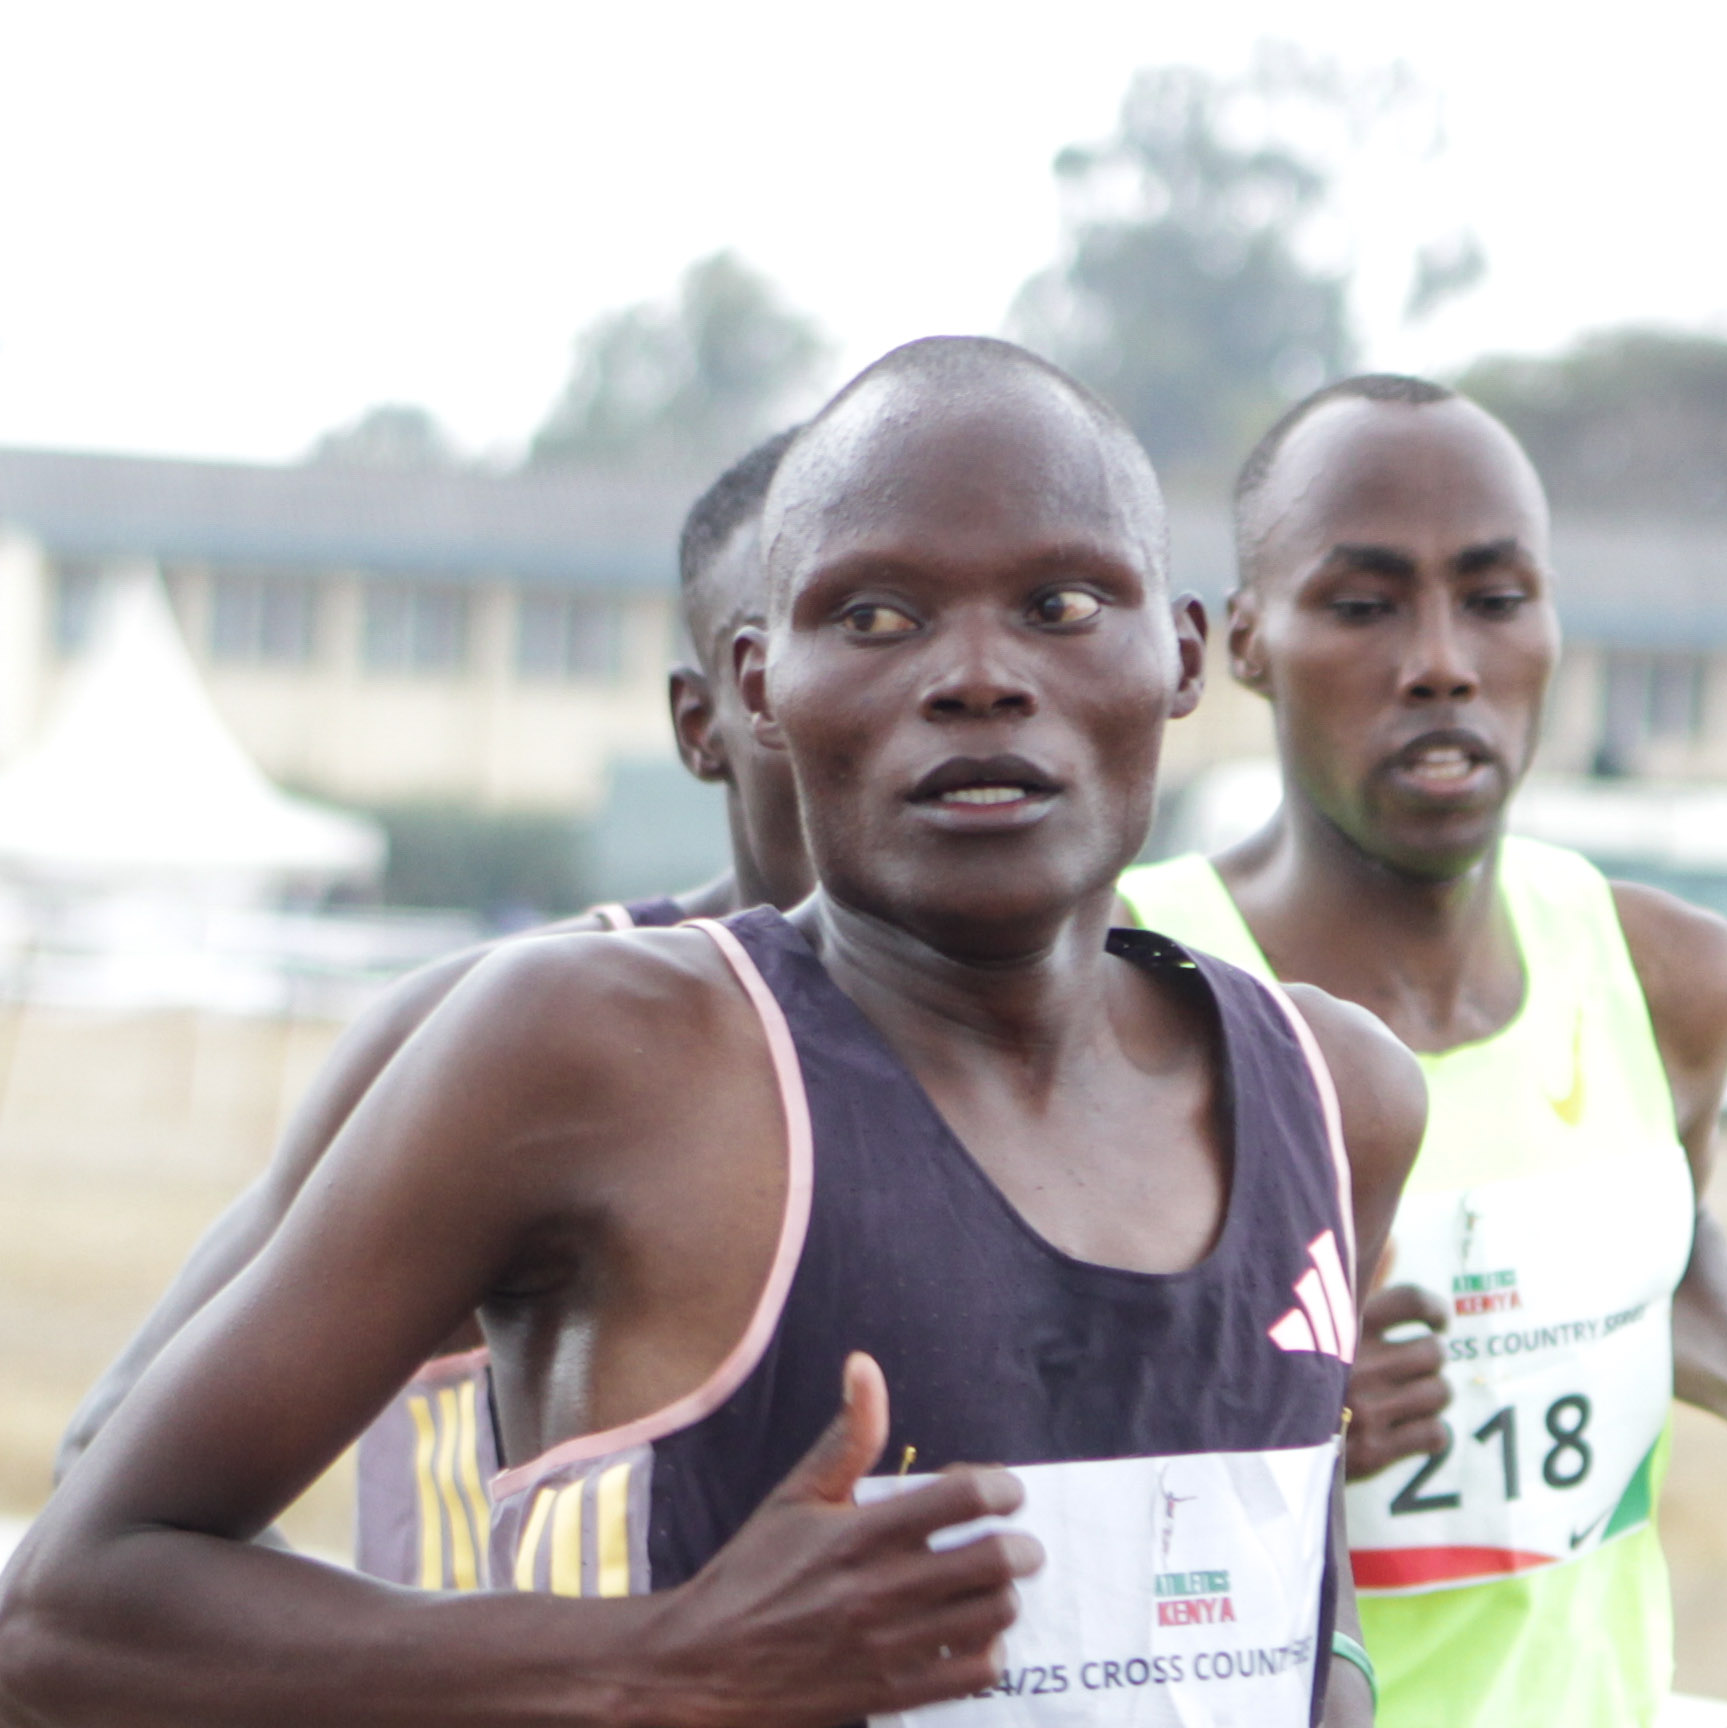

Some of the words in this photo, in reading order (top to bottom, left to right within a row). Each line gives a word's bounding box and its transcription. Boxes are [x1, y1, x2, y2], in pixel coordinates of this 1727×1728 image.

[1456, 1292, 1520, 1316] KENYA
[1487, 1319, 1597, 1357] COUNTRY
[1388, 1393, 1593, 1517] 218
[1158, 1597, 1235, 1627] KENYA
[970, 1663, 1069, 1699] 4/25
[1080, 1657, 1184, 1691] CROSS
